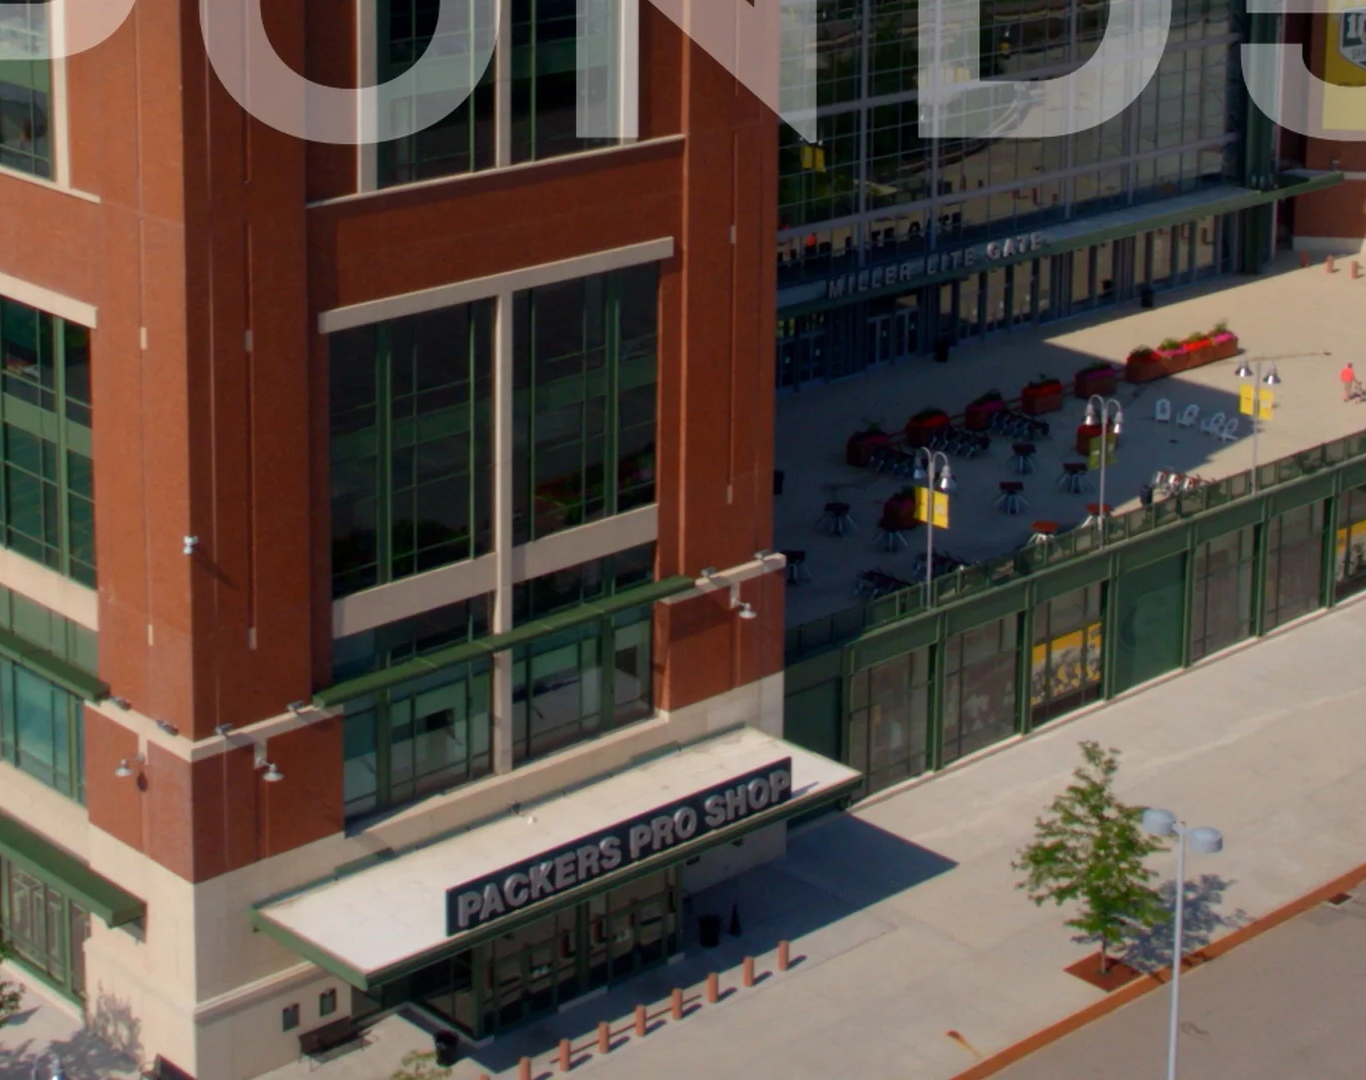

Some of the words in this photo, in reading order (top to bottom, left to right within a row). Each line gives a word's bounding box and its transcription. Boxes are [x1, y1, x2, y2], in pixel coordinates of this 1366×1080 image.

[827, 265, 912, 299] MILLER
[926, 248, 977, 274] LITE
[987, 232, 1043, 260] GATE
[457, 836, 621, 928] PACKERS
[629, 807, 697, 859] PRO
[704, 770, 791, 827] SHOP
